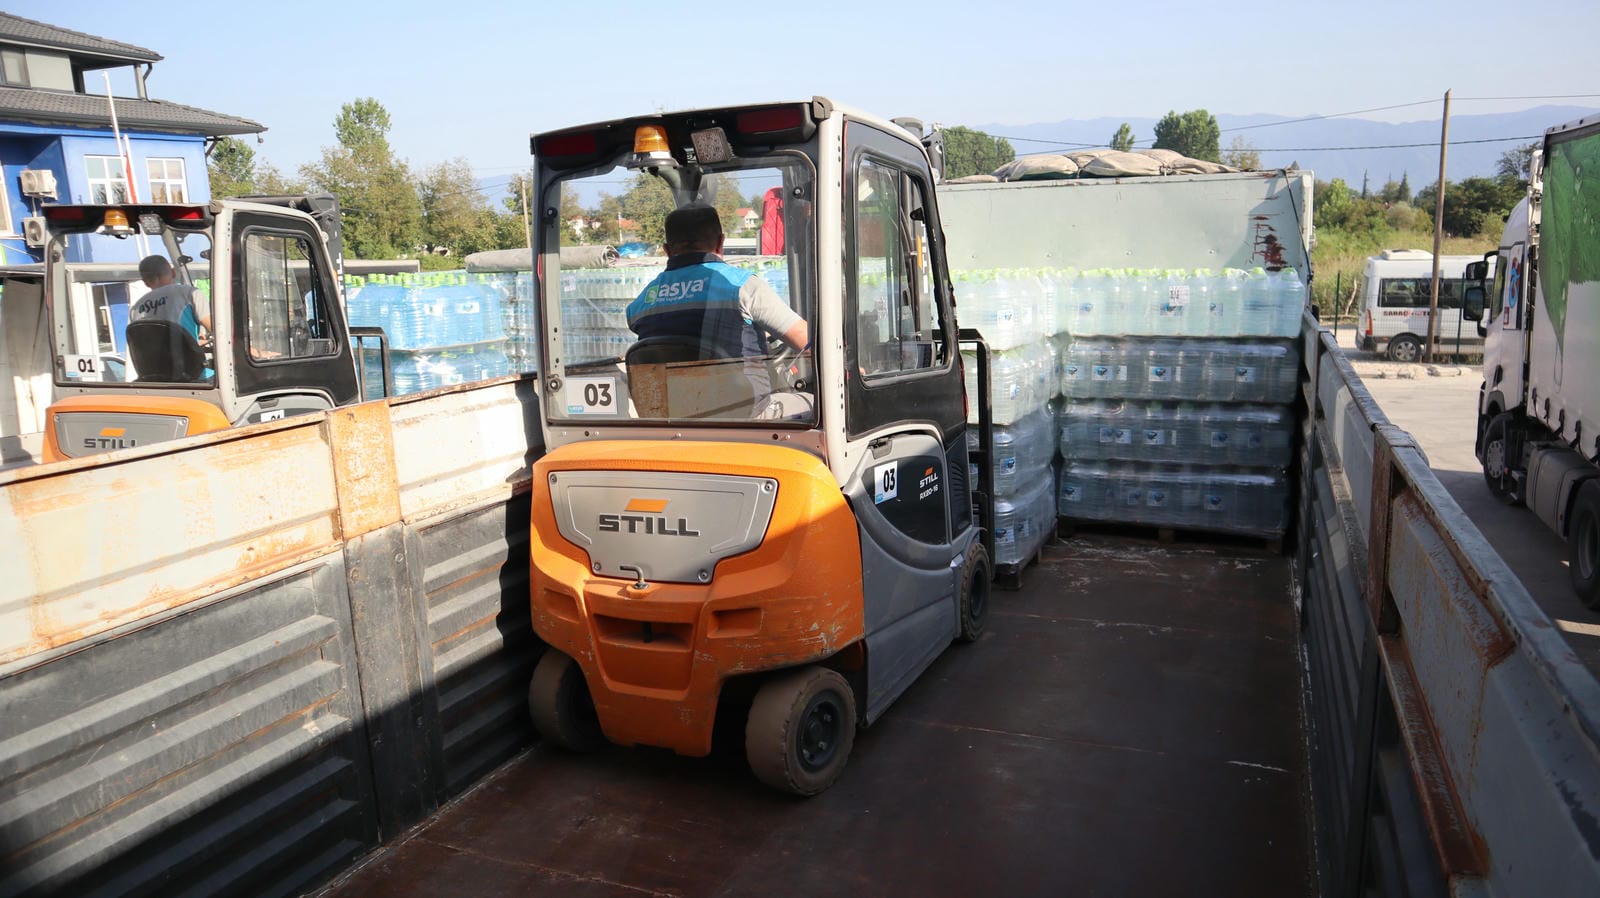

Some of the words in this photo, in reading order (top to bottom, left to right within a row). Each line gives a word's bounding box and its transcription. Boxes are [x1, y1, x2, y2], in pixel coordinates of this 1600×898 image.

[658, 279, 704, 300] asya
[138, 296, 166, 315] asya
[78, 358, 96, 373] 01
[584, 383, 612, 407] 03
[883, 468, 896, 493] 03
[919, 472, 939, 489] STILL
[599, 513, 700, 537] STILL
